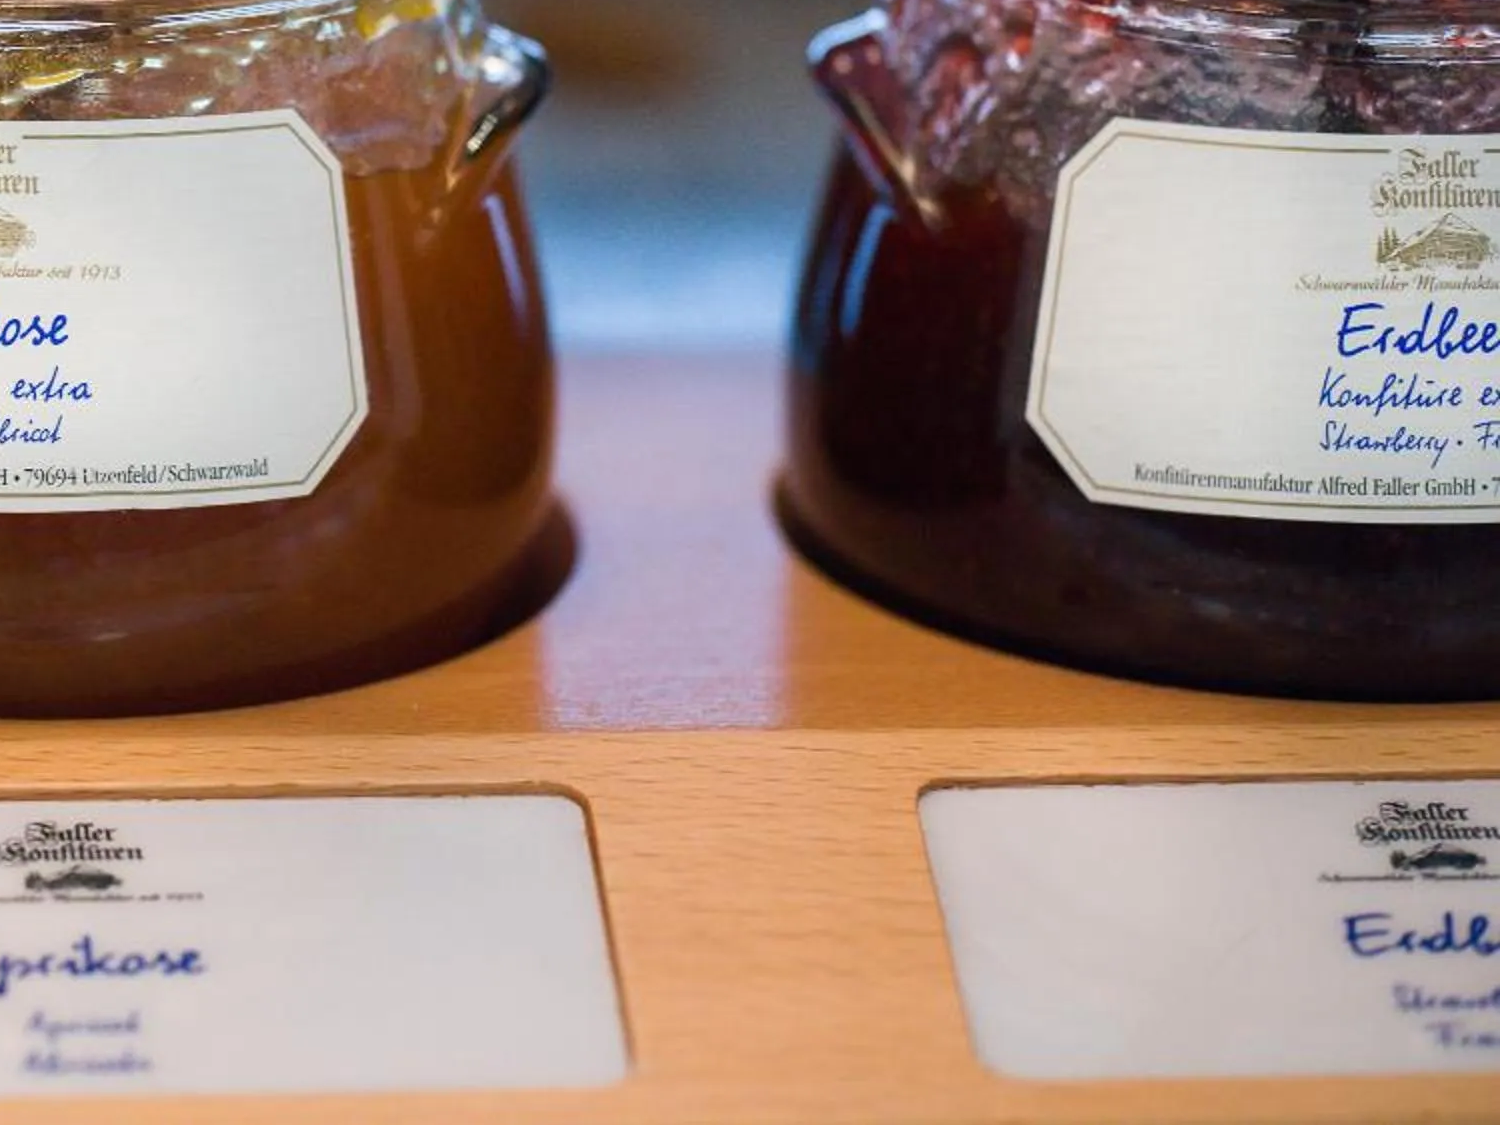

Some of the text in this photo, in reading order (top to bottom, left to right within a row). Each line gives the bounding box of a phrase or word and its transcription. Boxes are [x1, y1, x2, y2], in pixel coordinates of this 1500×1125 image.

[1399, 148, 1480, 184] Faller
[1370, 173, 1500, 217] Konfitüren
[46, 263, 72, 280] seit
[80, 264, 122, 281] 1913
[10, 364, 93, 402] extra
[1318, 366, 1463, 417] Konfitüre
[1319, 420, 1449, 469] Strawberry
[24, 468, 77, 488] 79694
[1134, 462, 1311, 493] Konfitürenmanufaktur
[1317, 475, 1367, 496] Alfred
[1373, 477, 1420, 496] Faller
[1425, 477, 1476, 496] GmbH
[1380, 801, 1469, 824] Faller
[25, 821, 116, 843] Faller
